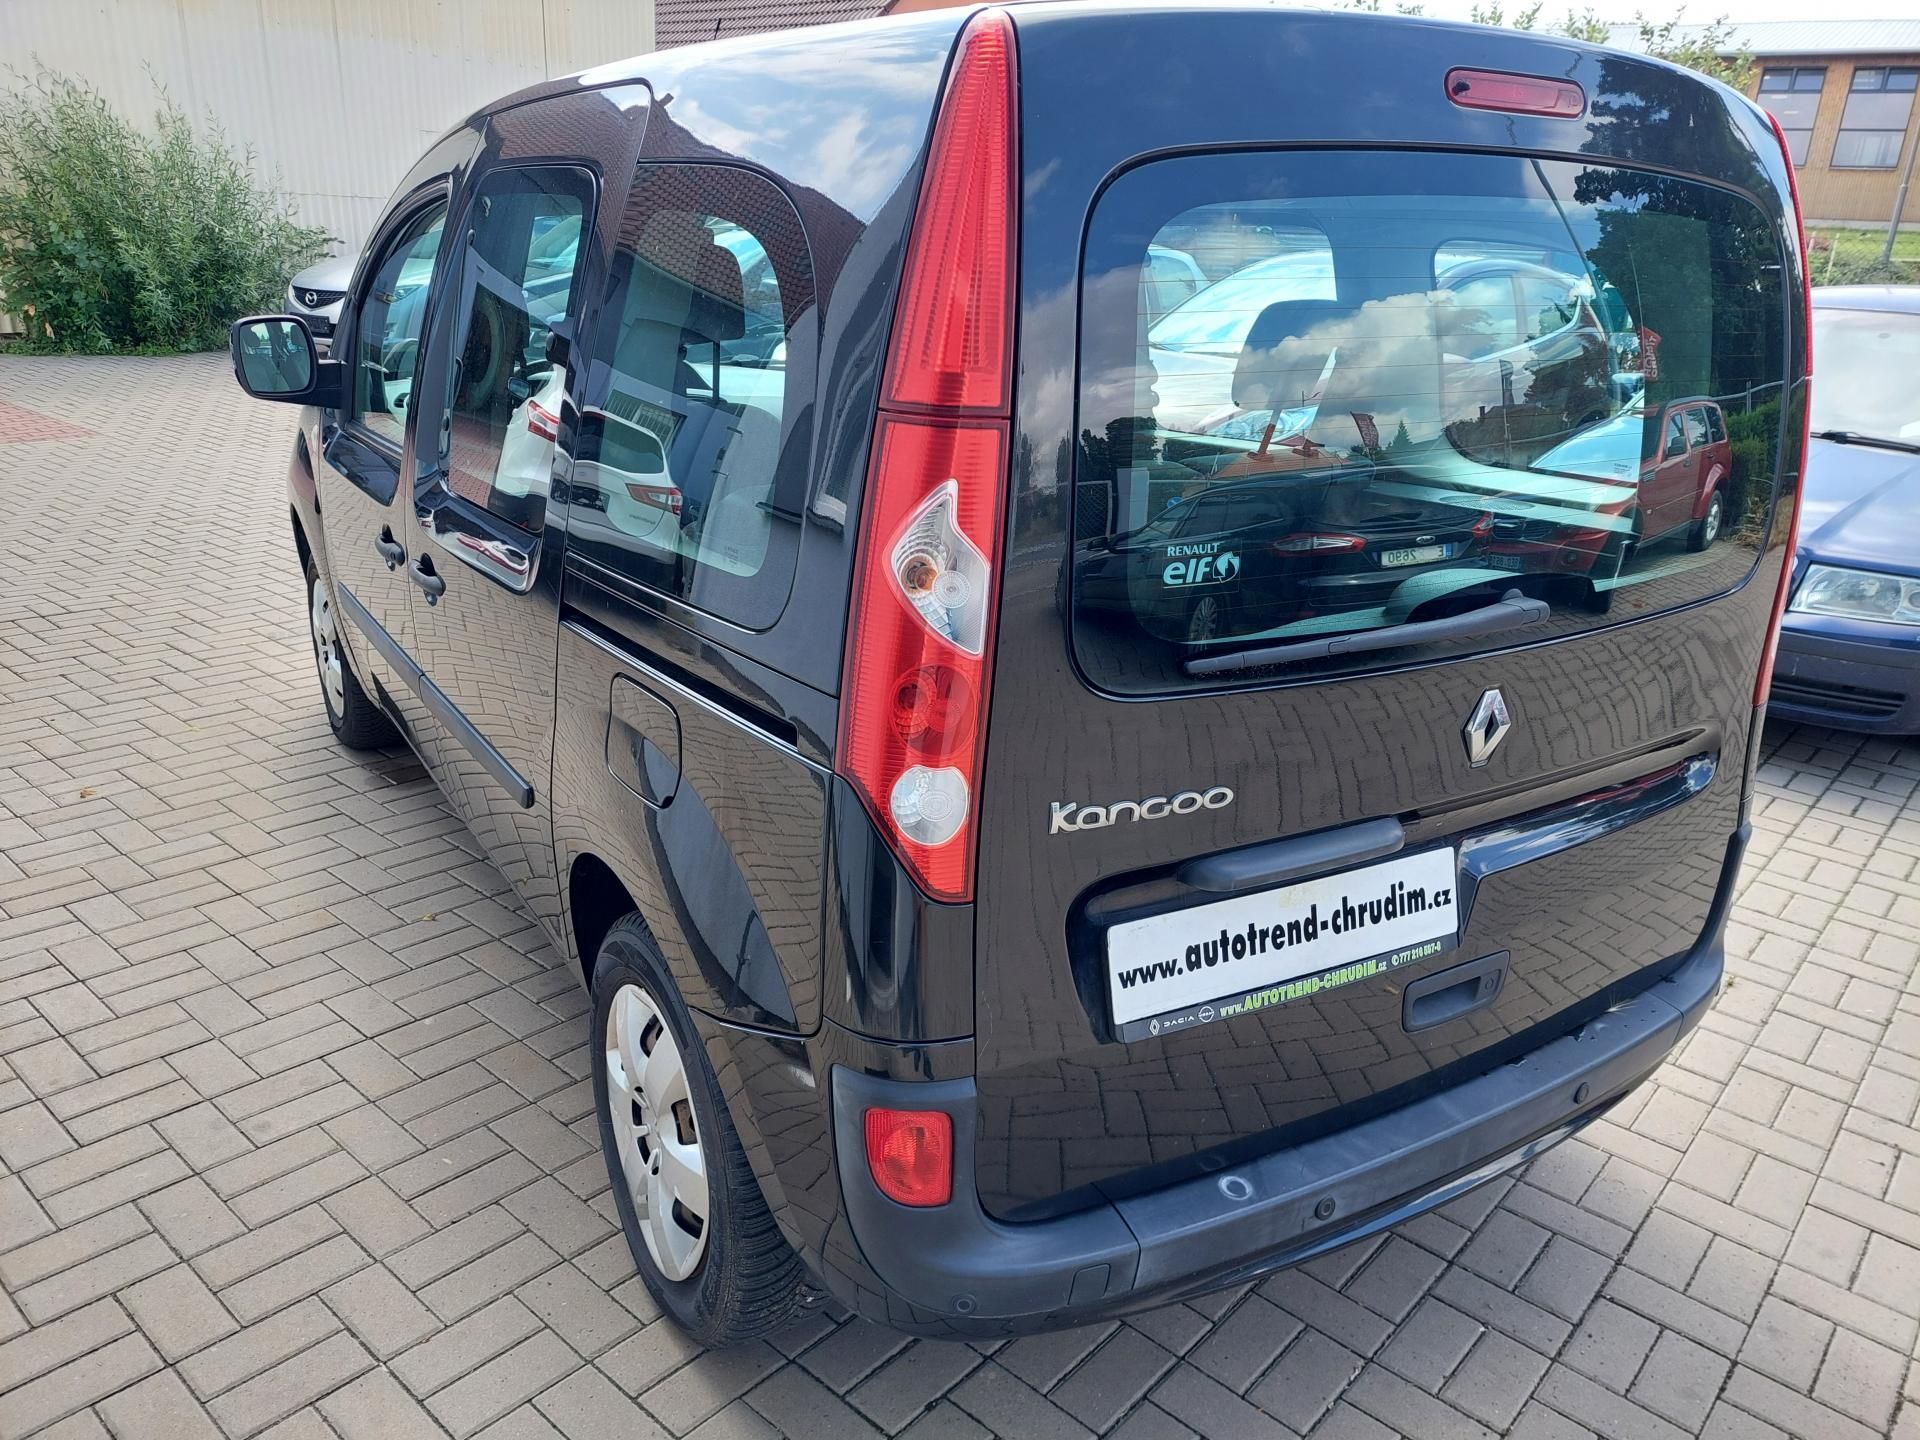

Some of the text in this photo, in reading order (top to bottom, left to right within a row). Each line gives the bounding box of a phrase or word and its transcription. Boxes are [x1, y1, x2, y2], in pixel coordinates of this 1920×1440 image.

[1163, 555, 1213, 585] elf
[1167, 541, 1224, 556] RENAULT
[1049, 786, 1235, 835] Kangoo
[1118, 881, 1452, 989] www.autotrend-chrudim.cz
[1163, 1015, 1195, 1028] DACIA
[1219, 959, 1388, 1017] www.AUTOTREND-CHRUDIM.cz
